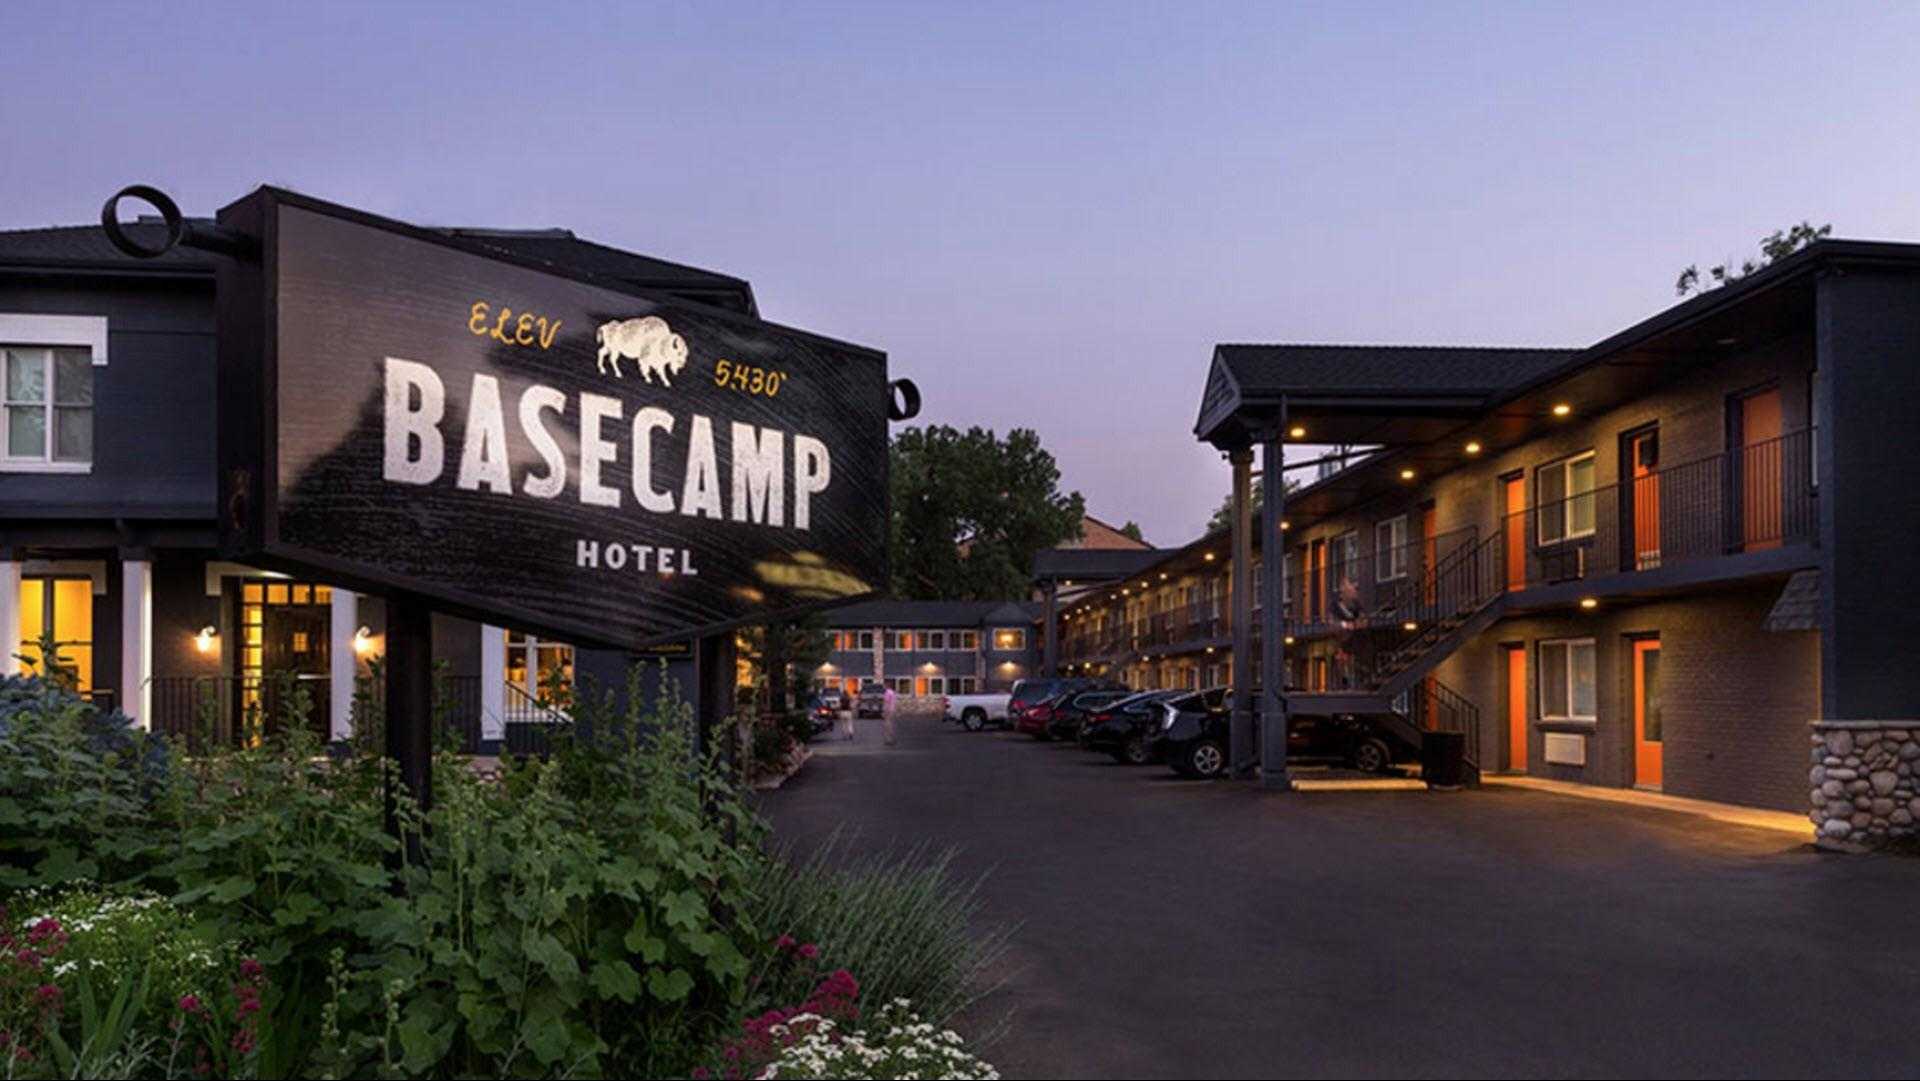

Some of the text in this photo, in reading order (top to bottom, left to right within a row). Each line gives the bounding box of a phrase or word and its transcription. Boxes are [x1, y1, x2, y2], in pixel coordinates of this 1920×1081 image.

[468, 302, 561, 349] ELEV
[383, 356, 831, 530] BASECAMP
[576, 540, 698, 575] HOTEL
